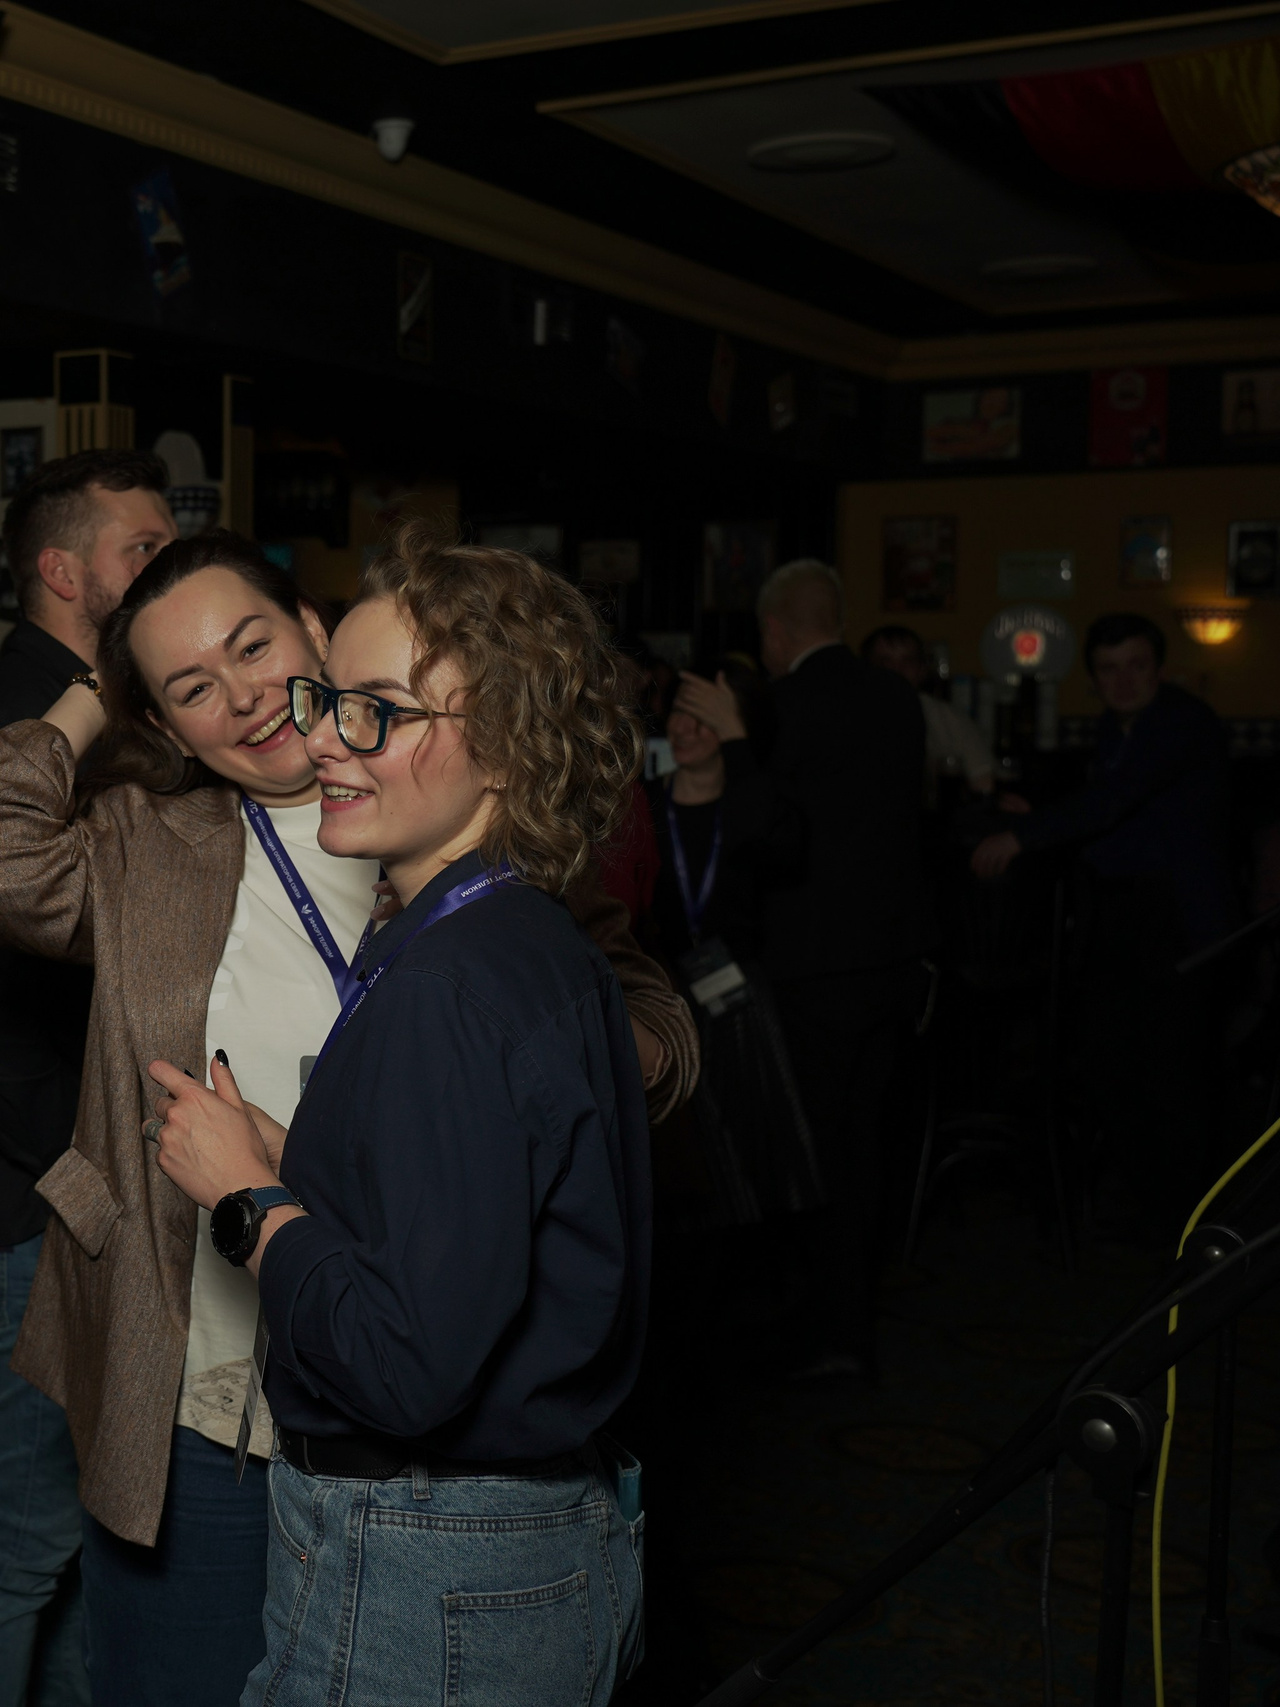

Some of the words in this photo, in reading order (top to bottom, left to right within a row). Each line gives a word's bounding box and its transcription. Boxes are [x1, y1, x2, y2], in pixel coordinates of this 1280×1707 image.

[255, 815, 276, 853] КОНФЕРЕНЦИЯ
[273, 851, 293, 884] ОПЕРАТОРОВ
[290, 881, 302, 900] СВЯЗИ
[460, 877, 493, 898] ТЕЛЕКОМ
[307, 915, 322, 939] ЭФФОРТ
[319, 934, 334, 959] ТЕЛЕКОМ
